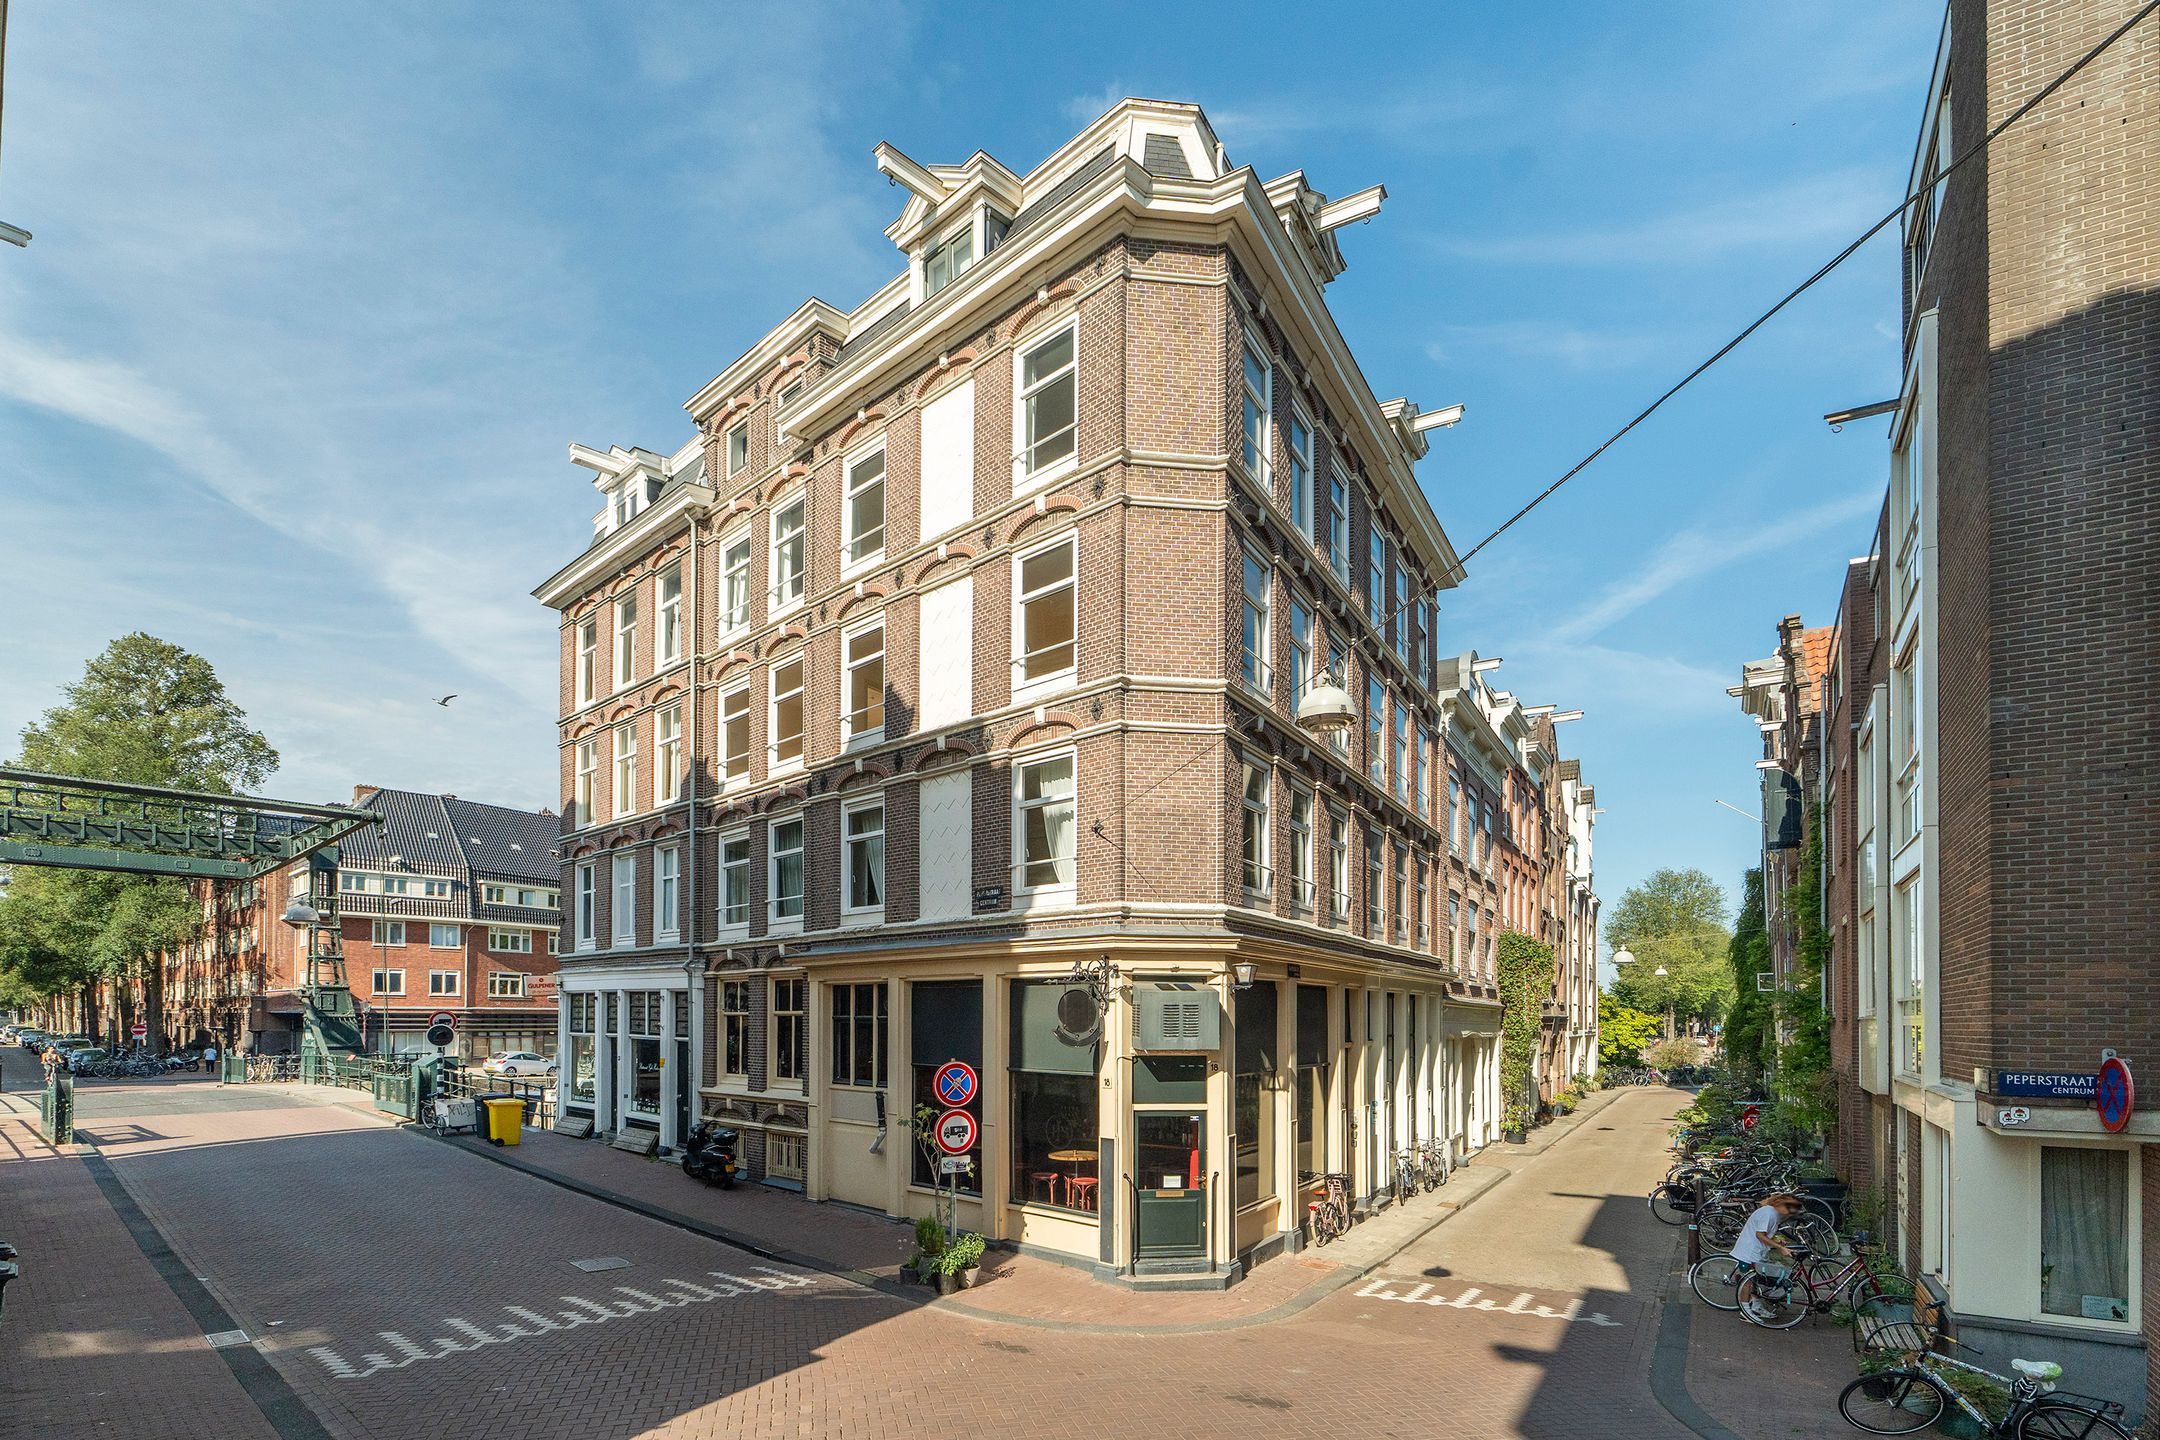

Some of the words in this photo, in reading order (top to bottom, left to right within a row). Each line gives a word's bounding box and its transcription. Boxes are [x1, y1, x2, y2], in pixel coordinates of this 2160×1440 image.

[1210, 1063, 1219, 1072] 18
[1103, 1078, 1111, 1087] 18
[2006, 1074, 2095, 1087] PEPERSTRAAT
[2052, 1087, 2095, 1095] CENTRUM
